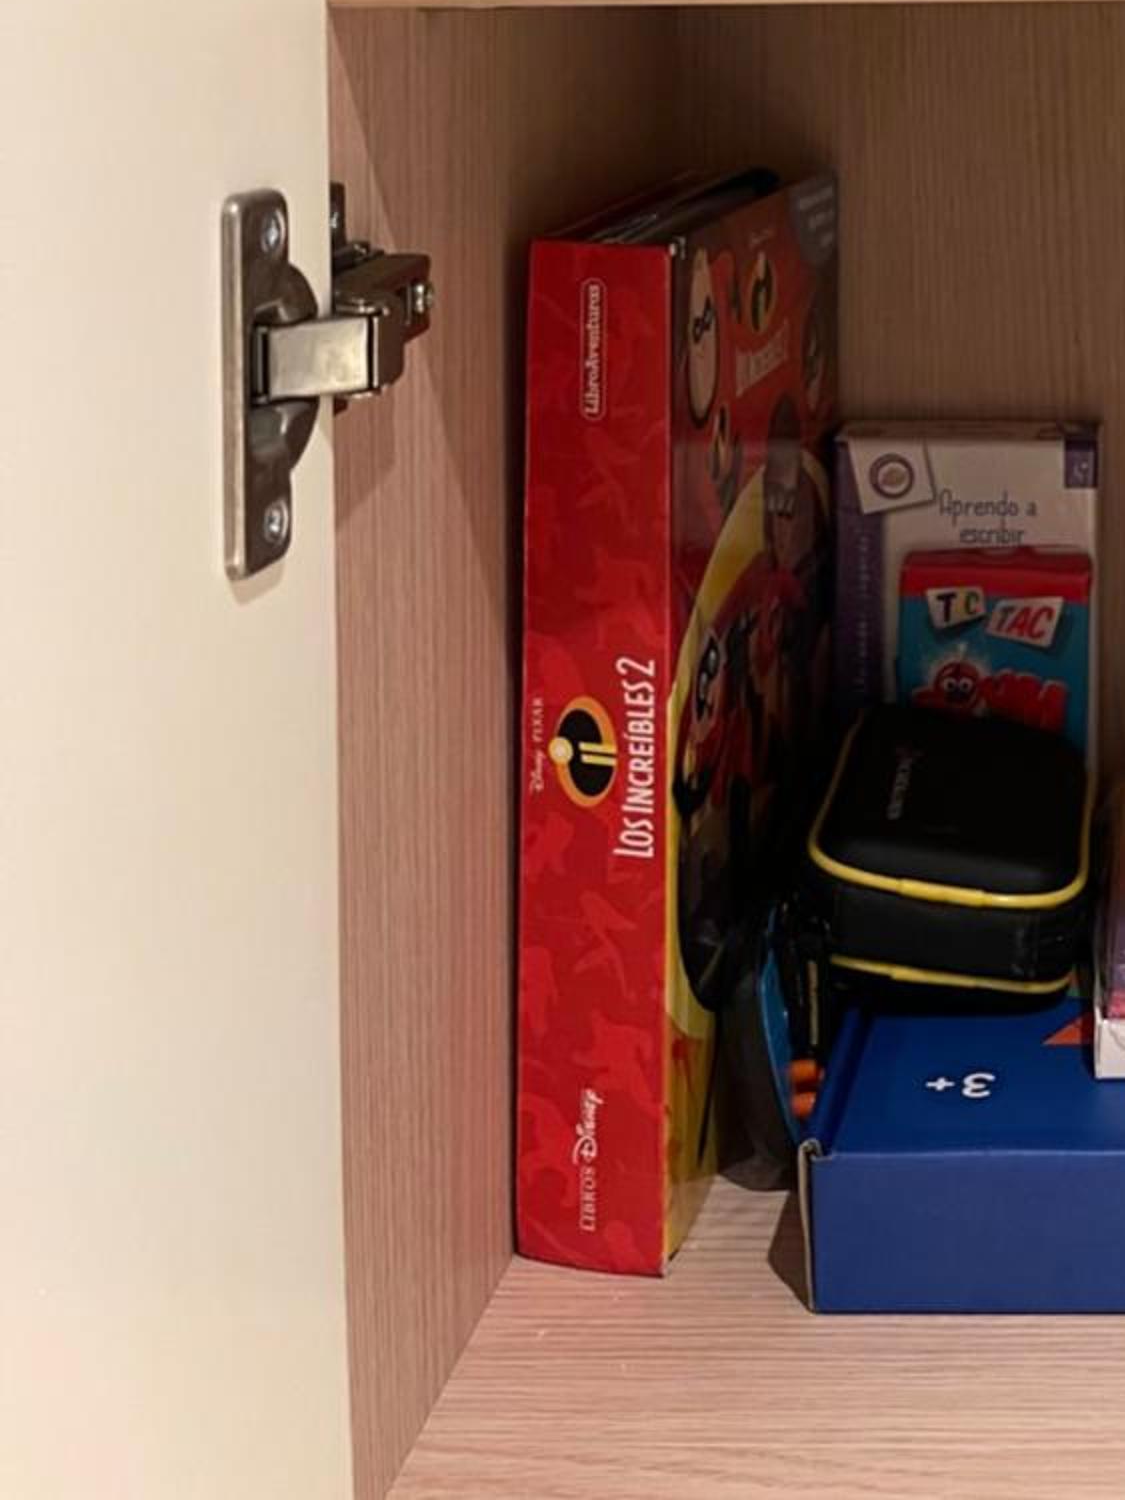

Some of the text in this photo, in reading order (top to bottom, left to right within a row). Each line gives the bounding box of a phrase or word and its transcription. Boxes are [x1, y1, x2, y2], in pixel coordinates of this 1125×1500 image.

[584, 283, 602, 416] LibroAventuras
[939, 488, 1037, 525] Aprendo a
[959, 524, 1025, 544] escribir
[996, 606, 1055, 639] TAC
[532, 696, 544, 743] PIXAR
[614, 657, 655, 858] LOS INCREÍBLES 2
[925, 1072, 996, 1098] 3+
[573, 1089, 604, 1232] LIBROS Disney
